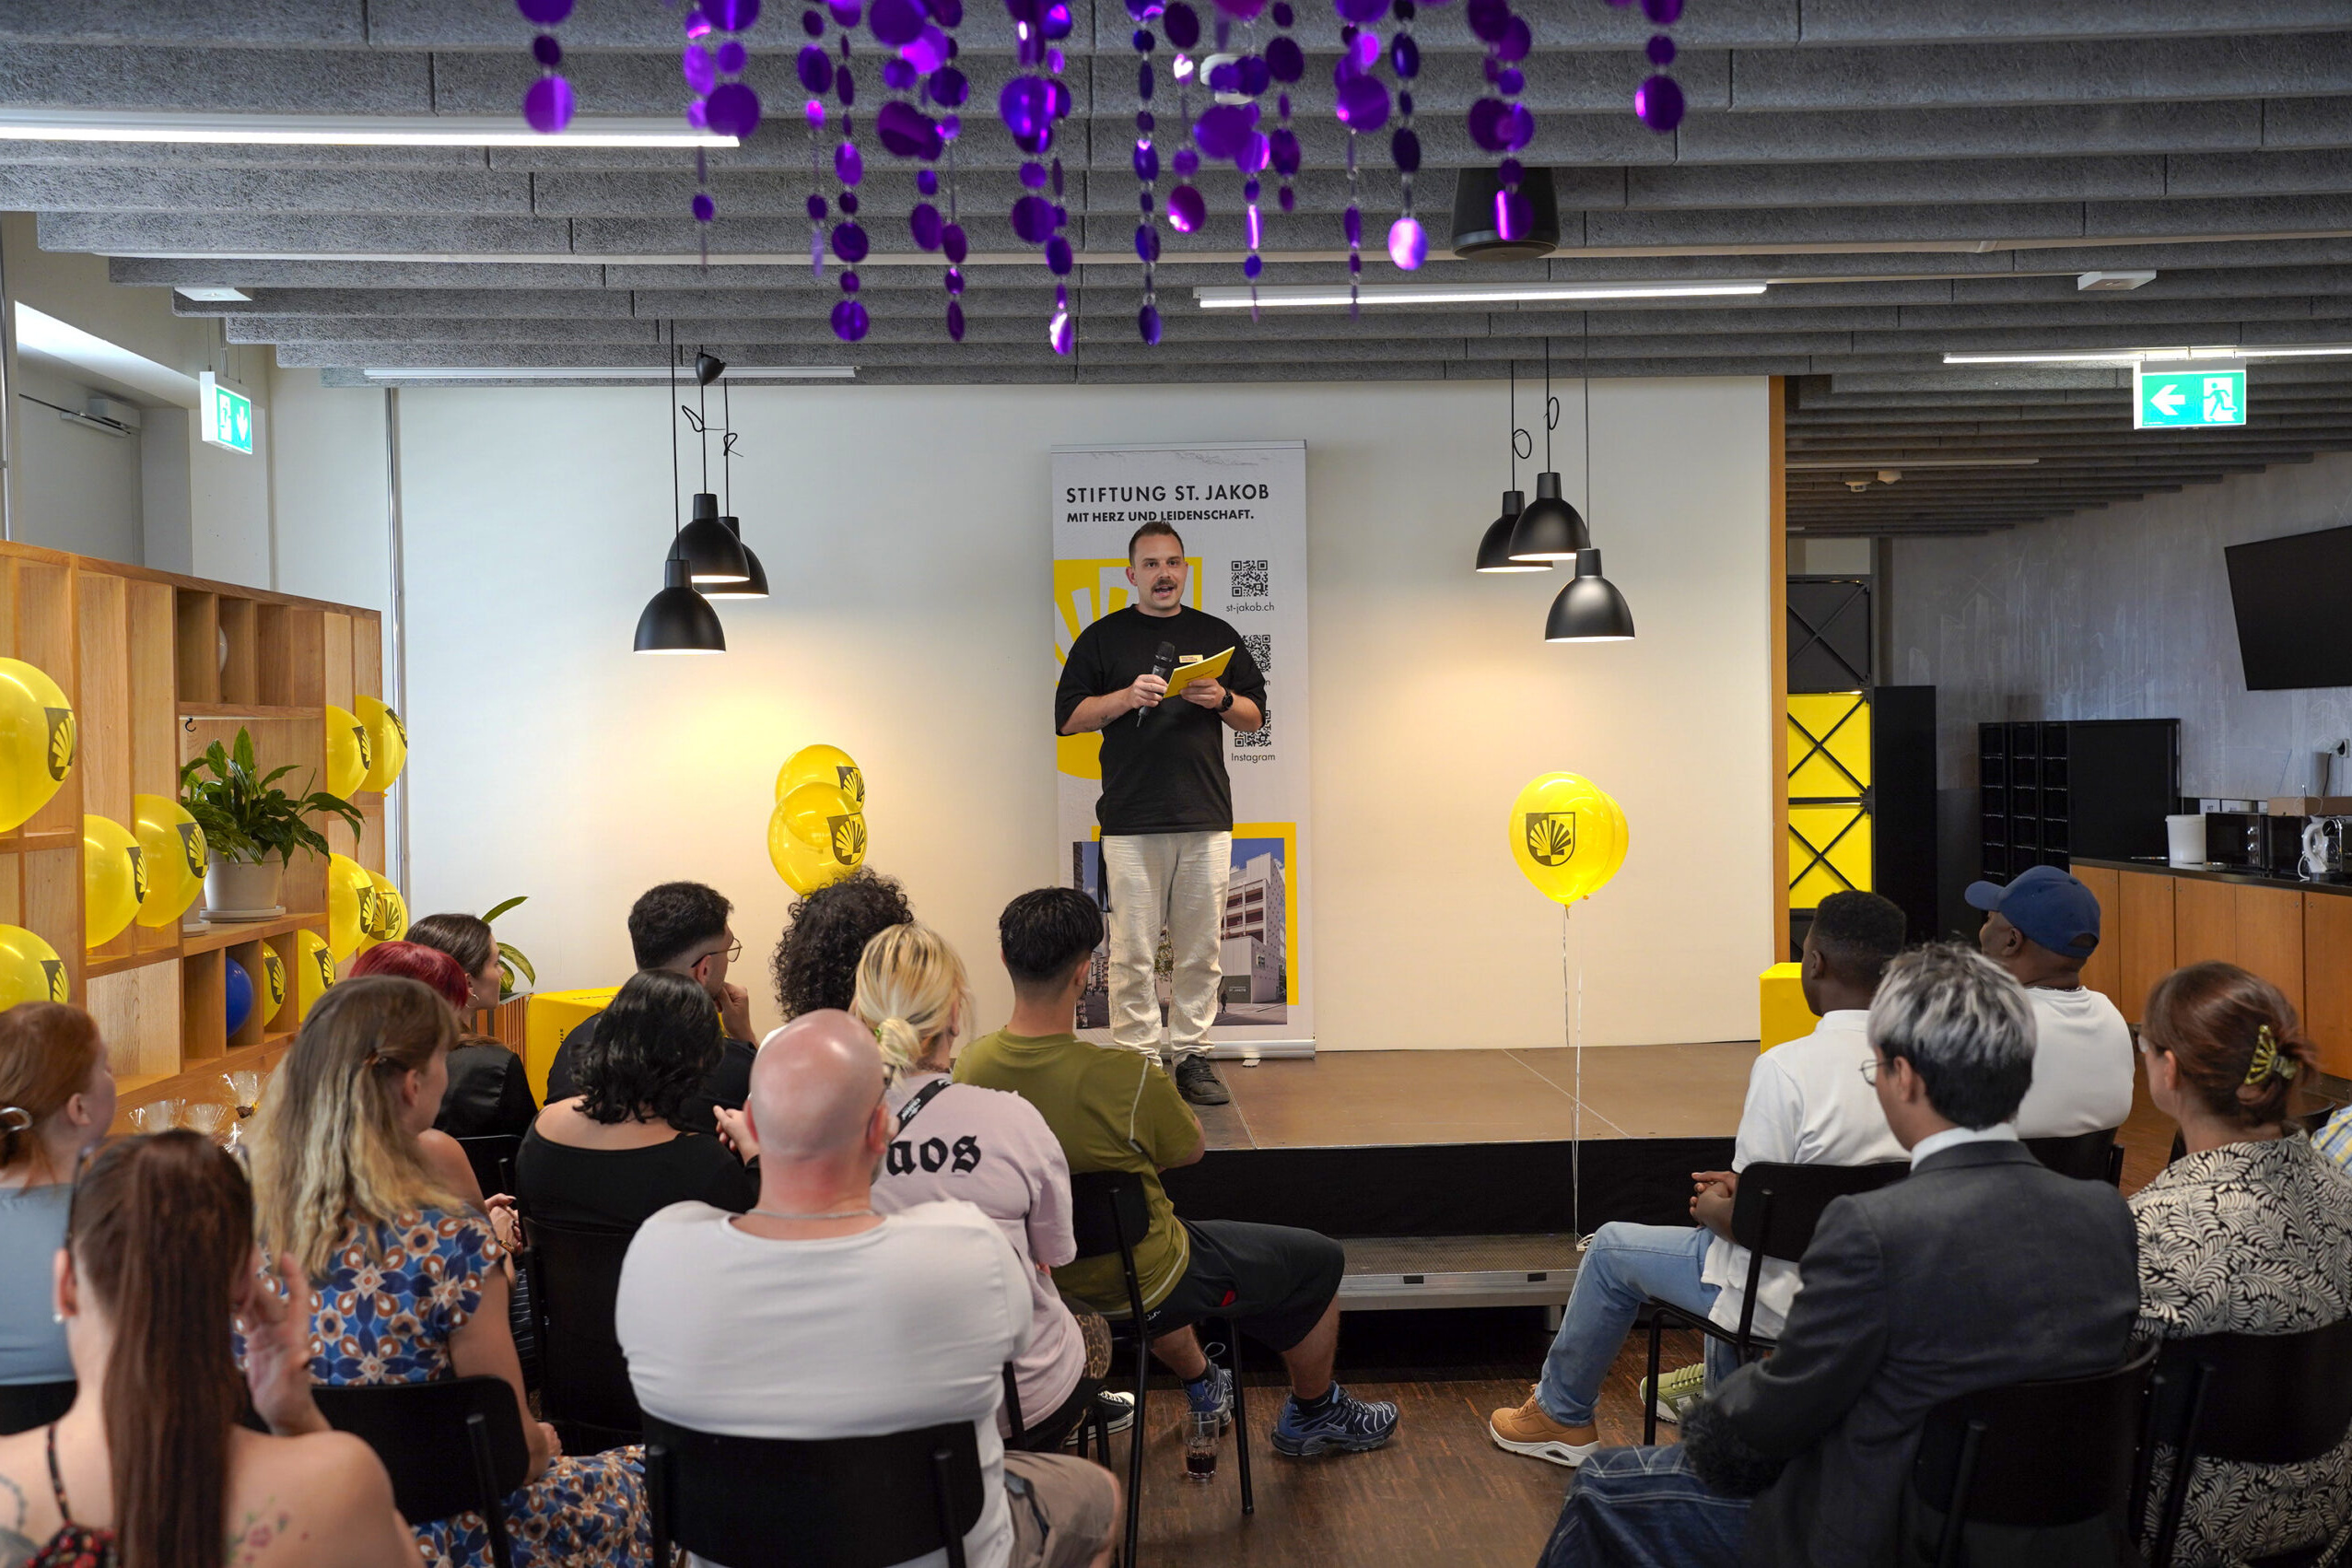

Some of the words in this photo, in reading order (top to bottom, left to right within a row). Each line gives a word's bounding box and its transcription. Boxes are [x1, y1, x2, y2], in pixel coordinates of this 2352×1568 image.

[1066, 486, 1166, 503] STIFTUNG
[1175, 485, 1199, 501] ST.
[1205, 484, 1270, 500] JAKOB
[1067, 512, 1089, 522] MIT
[1092, 511, 1125, 522] HERZ
[1128, 510, 1157, 521] UND
[1161, 509, 1255, 521] LEIDENSCHAFT.
[1226, 602, 1275, 614] st-jakob.ch
[1231, 753, 1276, 764] Instagram
